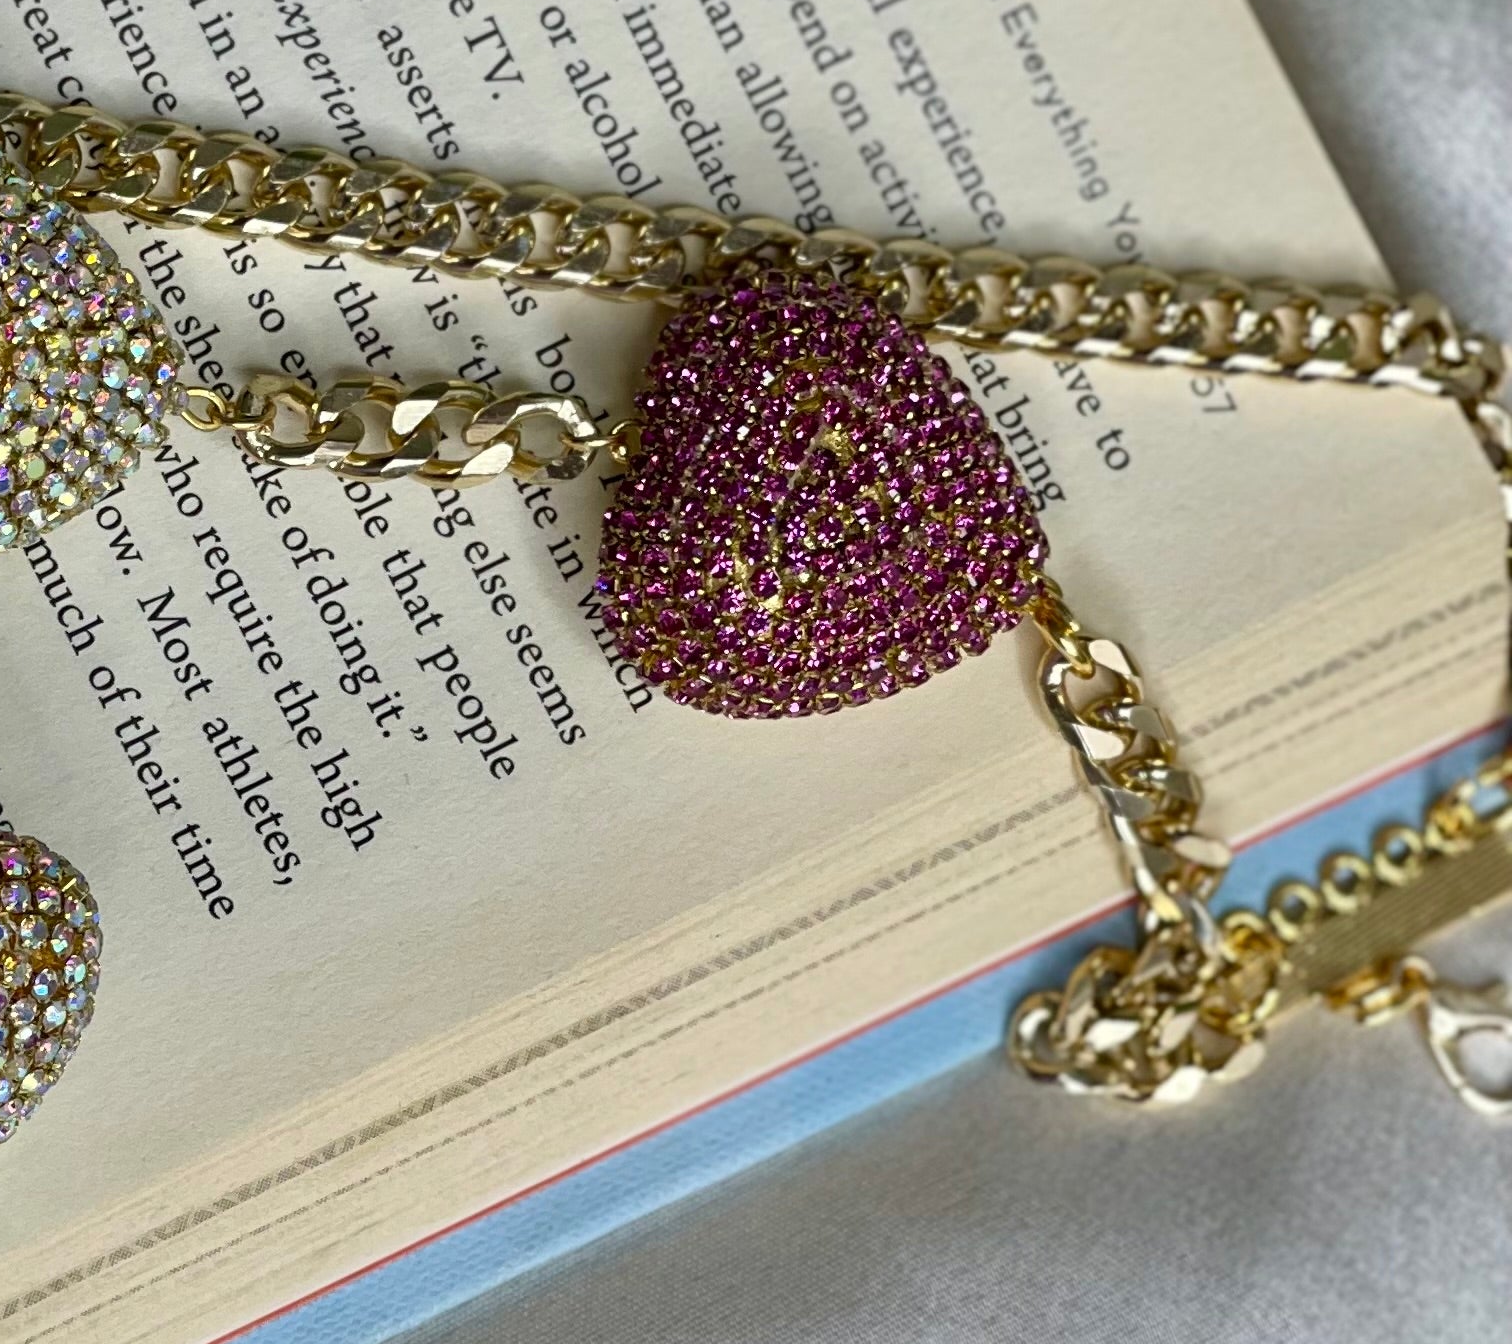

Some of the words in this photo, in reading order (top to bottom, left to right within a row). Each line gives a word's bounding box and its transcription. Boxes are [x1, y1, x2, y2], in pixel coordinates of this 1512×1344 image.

[198, 10, 236, 61] in
[224, 65, 265, 121] an
[376, 24, 460, 162] asserts
[463, 15, 525, 101] TV.
[539, 5, 578, 49] or
[563, 59, 663, 202] alcohol
[999, 1, 1111, 203] Everything
[734, 61, 839, 241] allowing
[1190, 367, 1238, 414] 57
[21, 537, 105, 657] much
[88, 665, 143, 710] of
[192, 526, 284, 676] require
[273, 679, 323, 750] the
[309, 747, 383, 853] high
[382, 549, 444, 636] that
[415, 643, 519, 780] people
[114, 715, 183, 815] their
[136, 586, 214, 702] Most
[201, 717, 301, 886] athletes,
[170, 823, 235, 920] time
